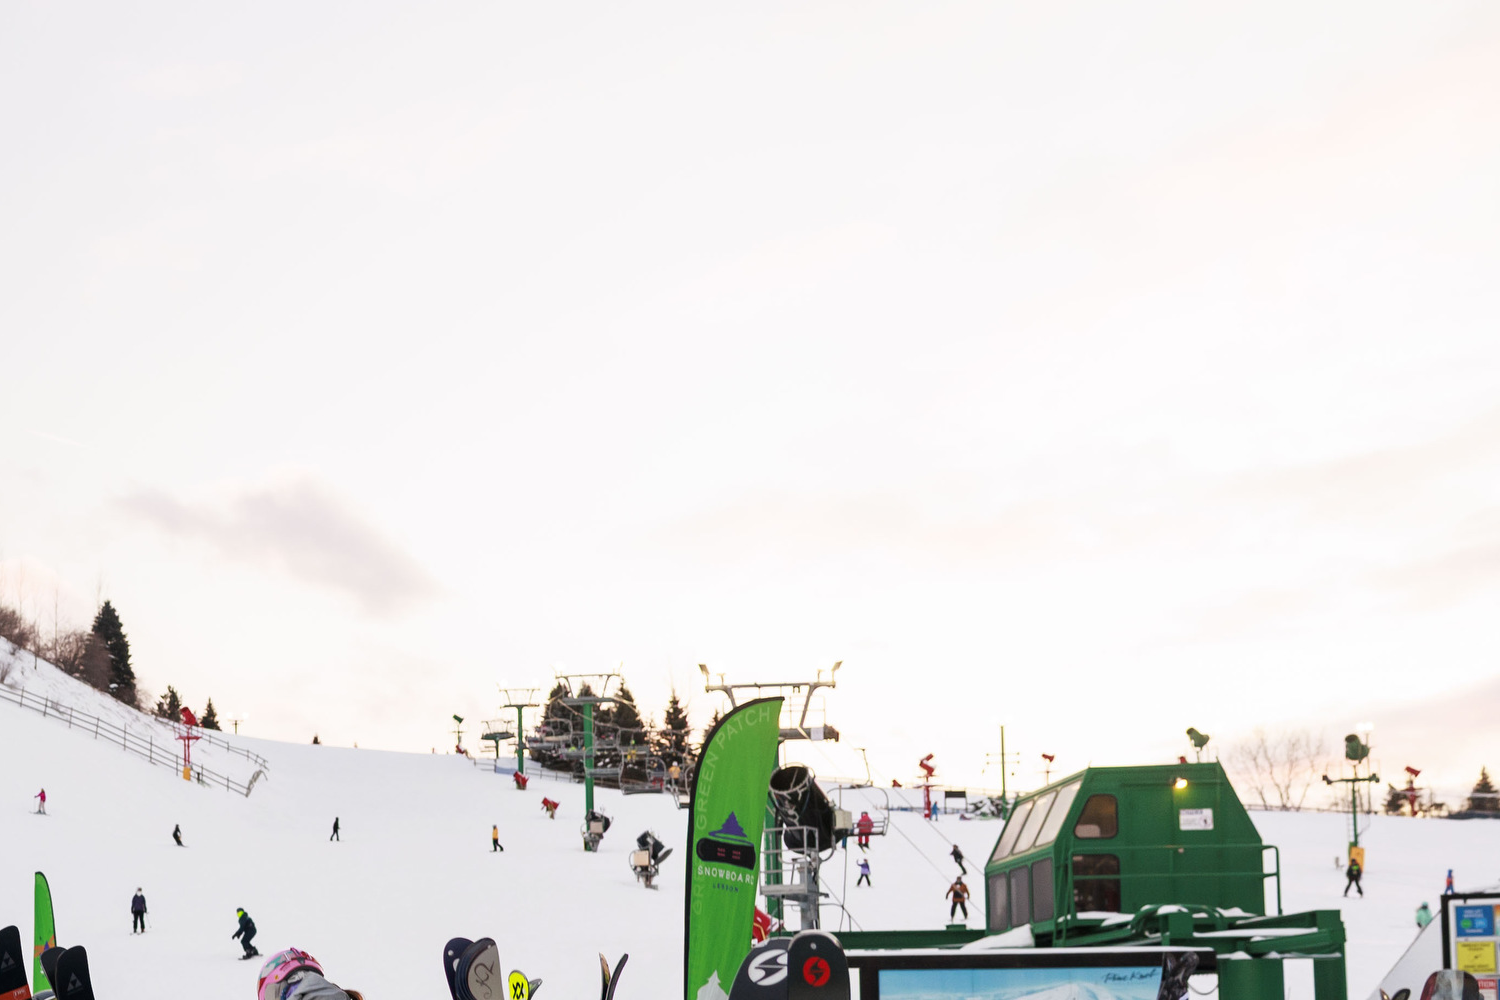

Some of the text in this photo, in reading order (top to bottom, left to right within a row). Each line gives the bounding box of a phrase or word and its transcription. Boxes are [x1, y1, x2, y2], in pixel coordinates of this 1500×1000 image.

[696, 706, 770, 830] GREEN PATCH
[697, 864, 754, 886] SNOWBOARD
